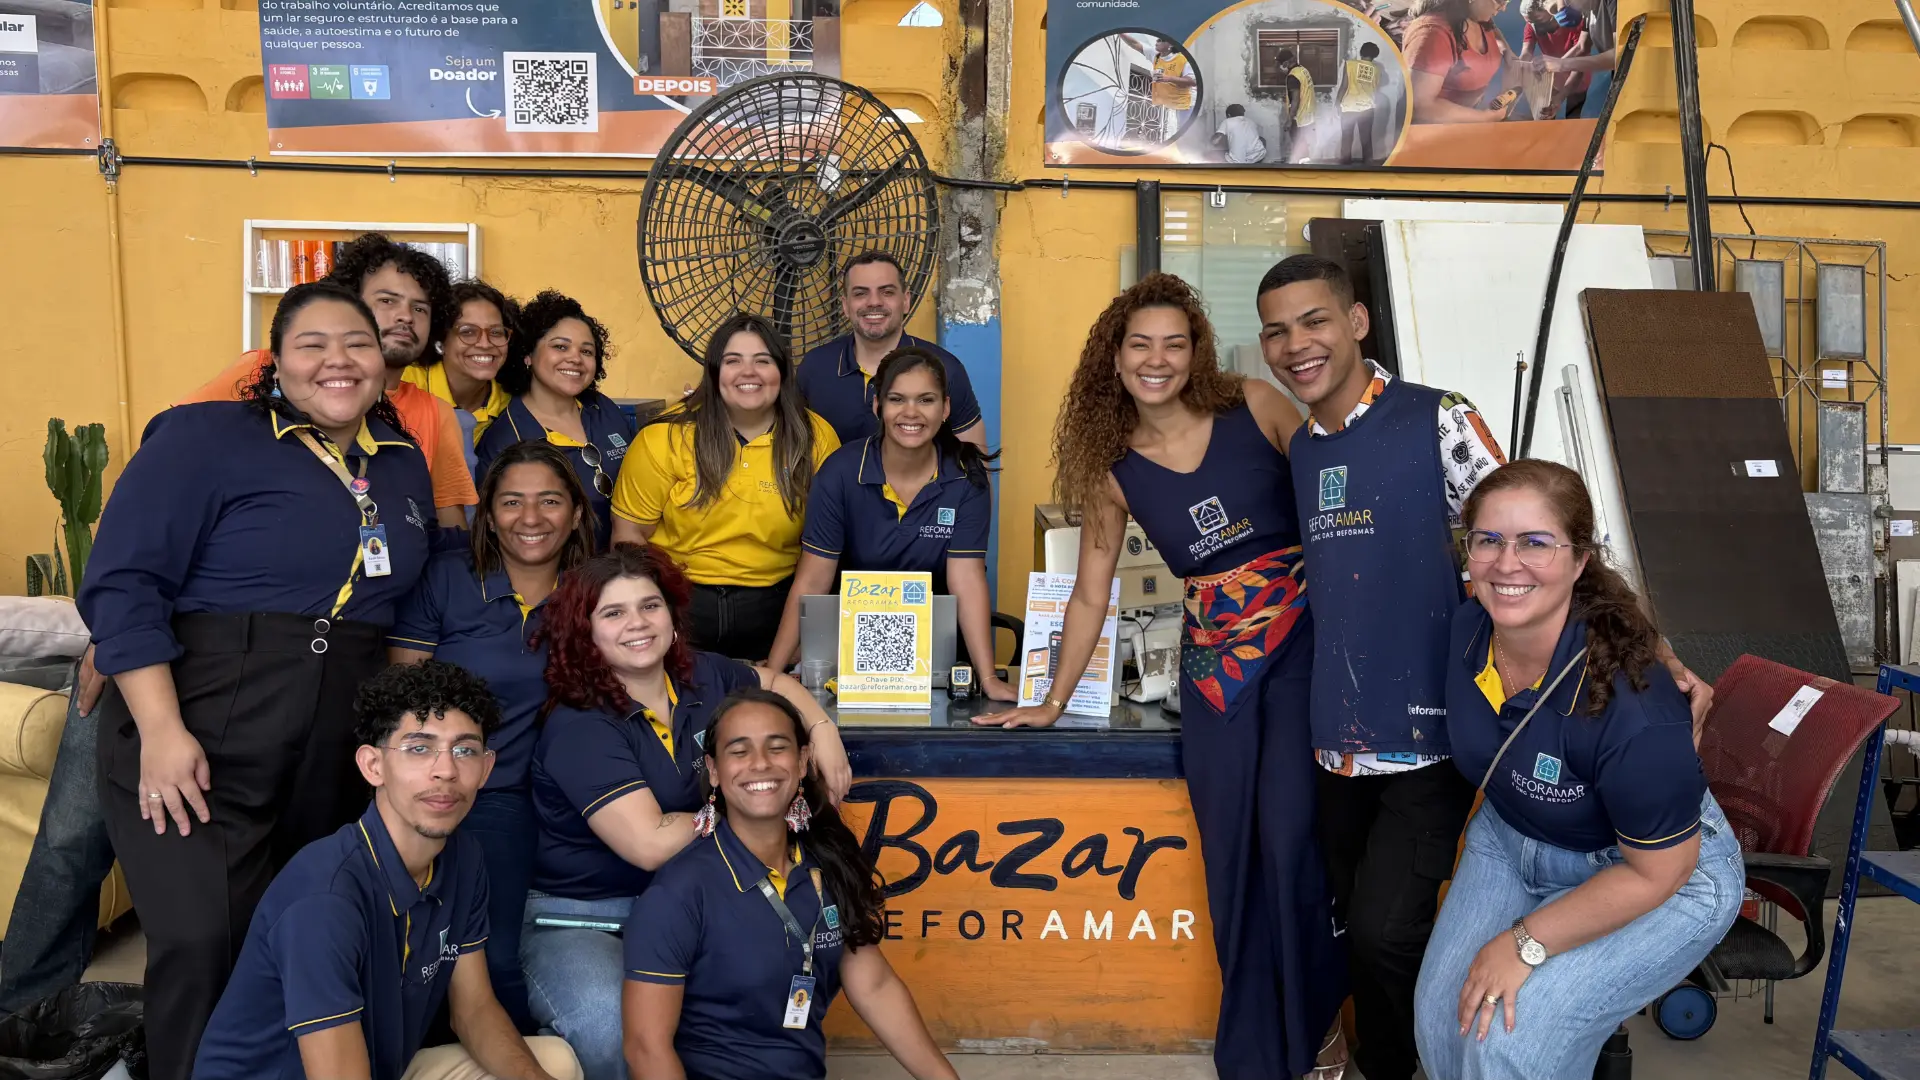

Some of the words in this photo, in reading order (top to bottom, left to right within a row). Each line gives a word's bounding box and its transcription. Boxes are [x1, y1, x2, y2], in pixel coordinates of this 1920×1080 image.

[262, 1, 278, 9] do
[281, 0, 330, 10] trabalho
[333, 0, 395, 10] voluntário.
[398, 1, 473, 11] Acreditamos
[476, 4, 499, 13] que
[1076, 0, 1140, 8] comunidade.
[287, 13, 301, 22] lar
[304, 15, 345, 24] seguro
[361, 14, 428, 24] estruturado
[431, 15, 438, 24] é
[451, 15, 479, 24] base
[482, 17, 508, 26] para
[511, 17, 518, 25] a
[264, 26, 302, 36] saúde,
[305, 28, 312, 36] a
[315, 27, 381, 36] autoestima
[405, 27, 441, 36] futuro
[444, 28, 460, 37] de
[265, 40, 318, 50] qualquer
[321, 41, 365, 50] pessoa.
[445, 55, 472, 69] Seja
[476, 58, 495, 66] um
[312, 67, 318, 76] 3
[429, 68, 497, 81] Doador
[638, 79, 712, 92] DEPOIS
[1188, 517, 1252, 555] REFORAMAR
[1223, 527, 1255, 546] REFORMAS
[1336, 527, 1375, 537] REFORMAS
[846, 578, 900, 598] Bazar
[840, 682, 928, 691] bazar@reforamar.org.br
[865, 676, 888, 684] Chave
[890, 676, 905, 684] PIX:
[1511, 769, 1585, 798] REFORAMAR
[842, 779, 1188, 901] Bazar
[883, 909, 1196, 941] EFORAMAR
